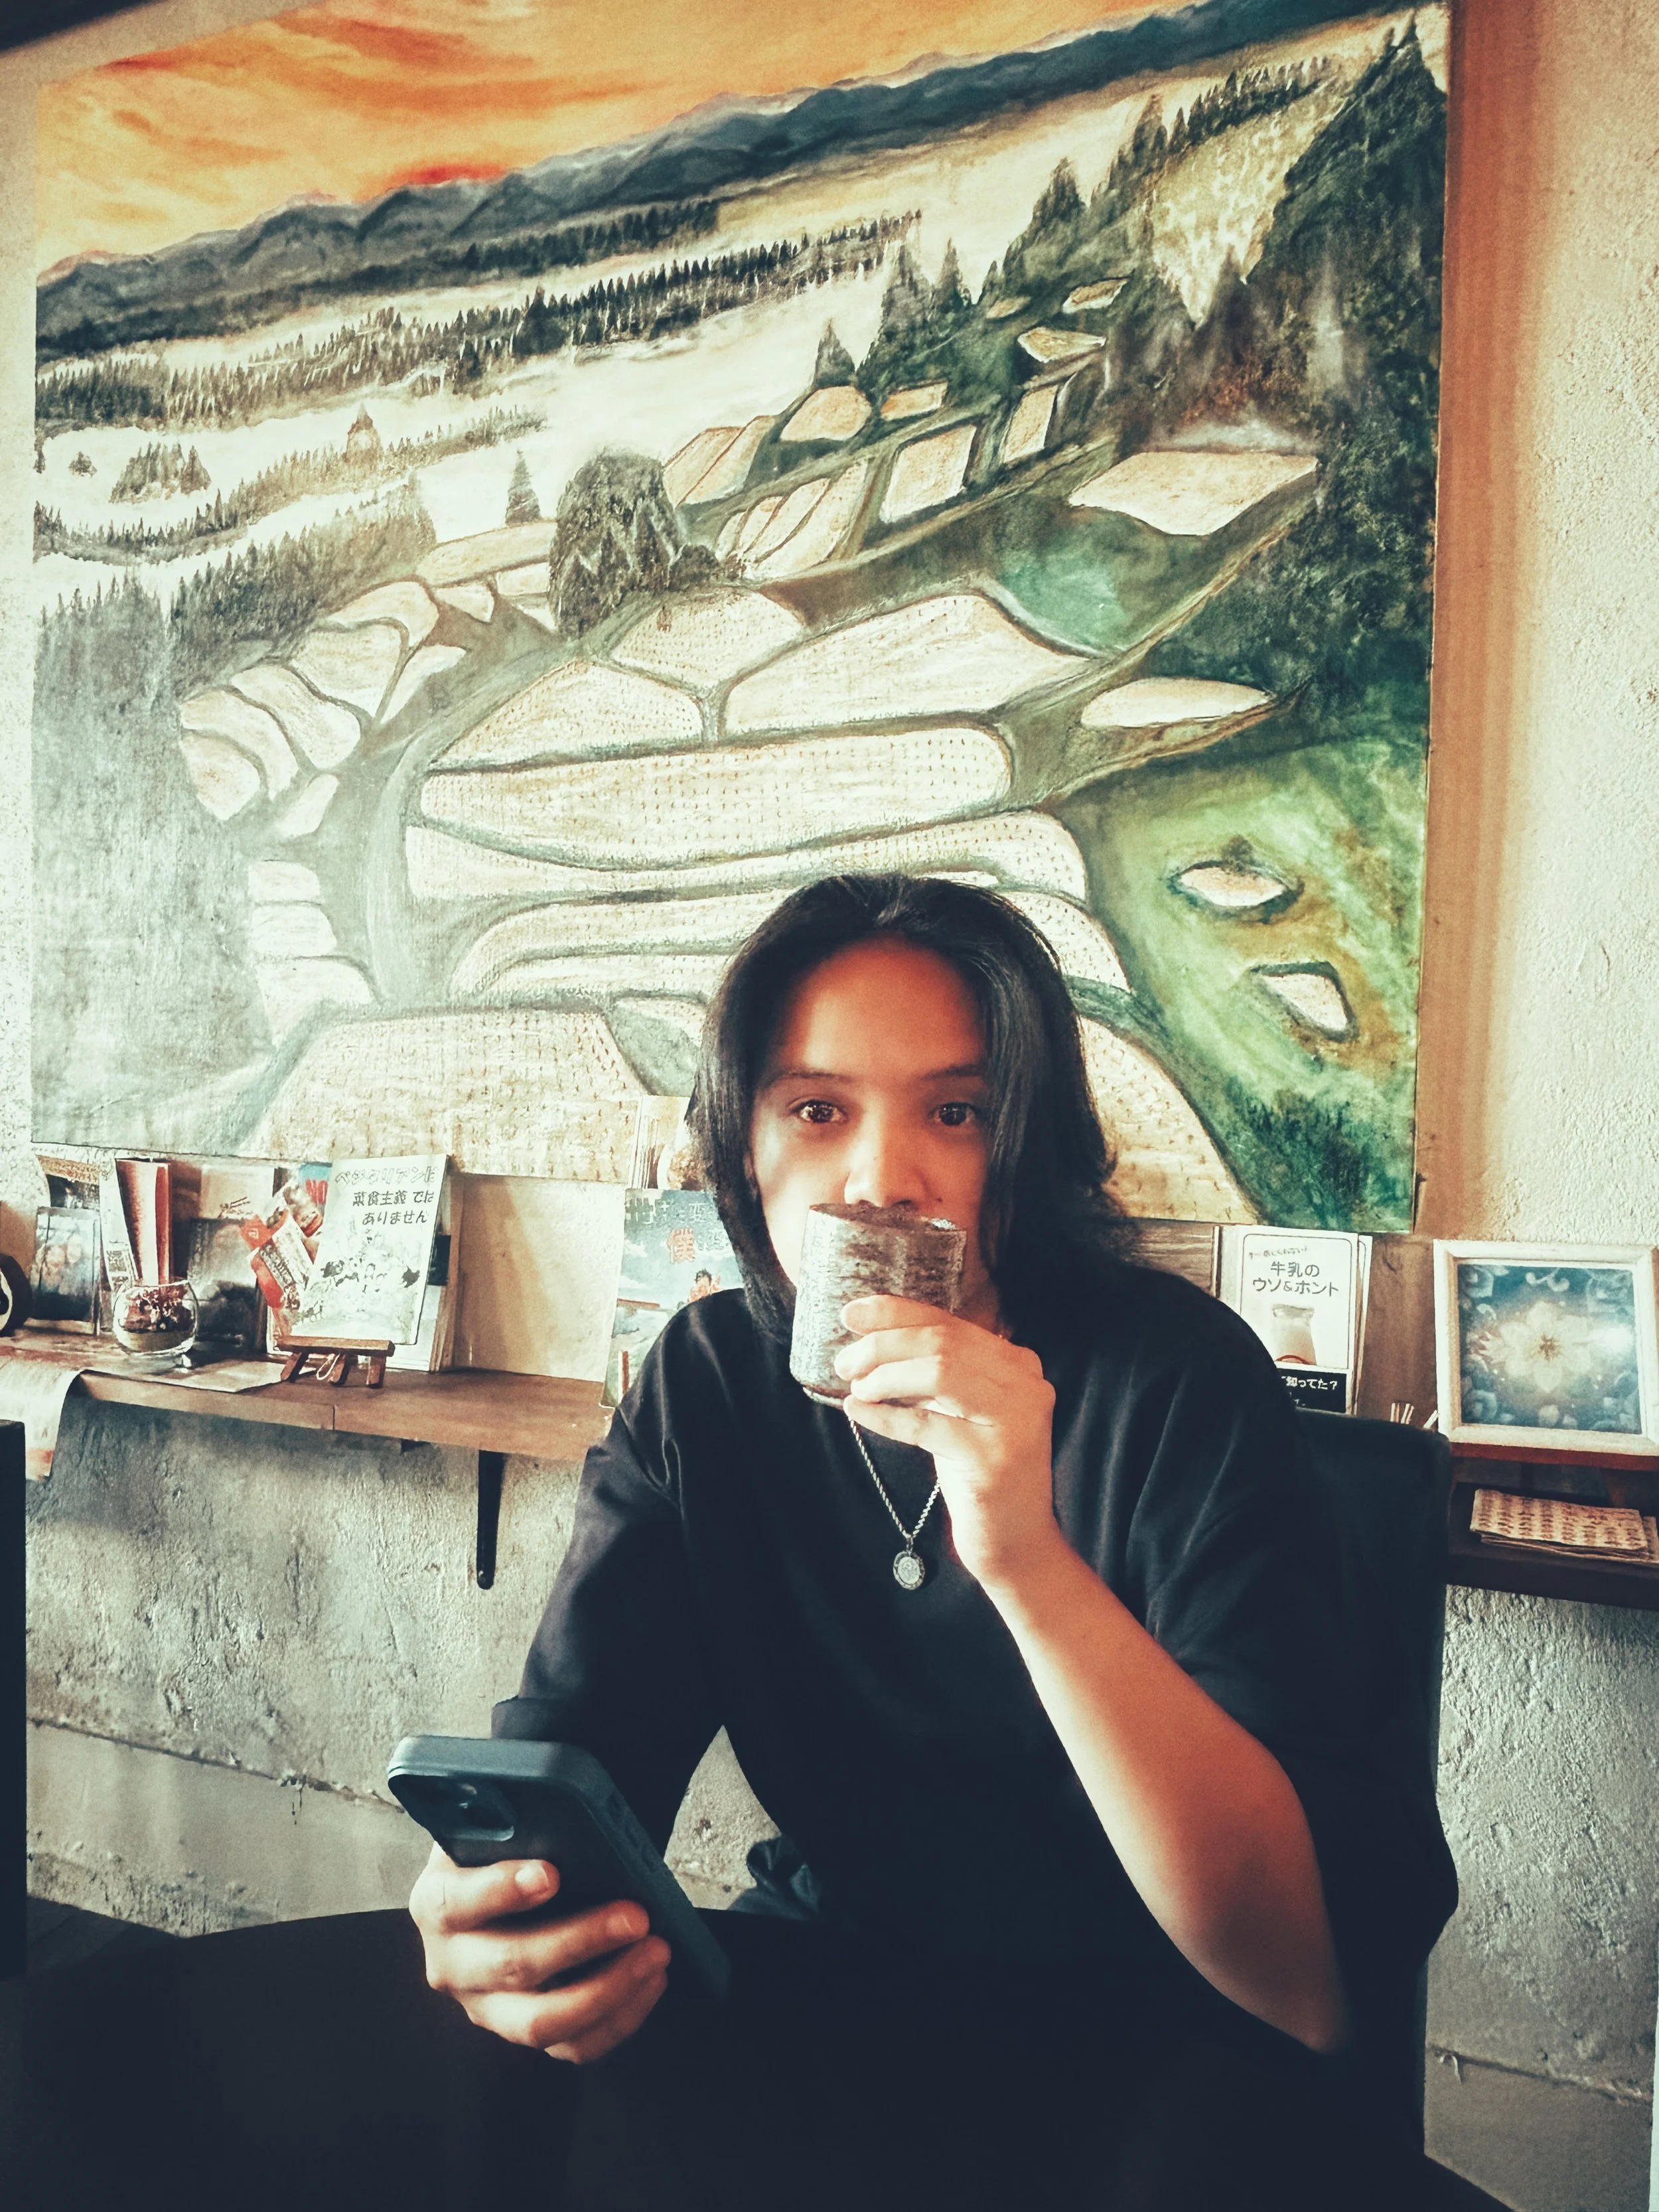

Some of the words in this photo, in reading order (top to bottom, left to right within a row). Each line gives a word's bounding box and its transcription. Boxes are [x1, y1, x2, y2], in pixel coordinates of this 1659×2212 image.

[362, 1210, 427, 1226] ありません
[1270, 1261, 1319, 1278] 牛乳の
[1252, 1277, 1339, 1297] ウソ&ホント
[1281, 1375, 1338, 1390] 知ってた？
